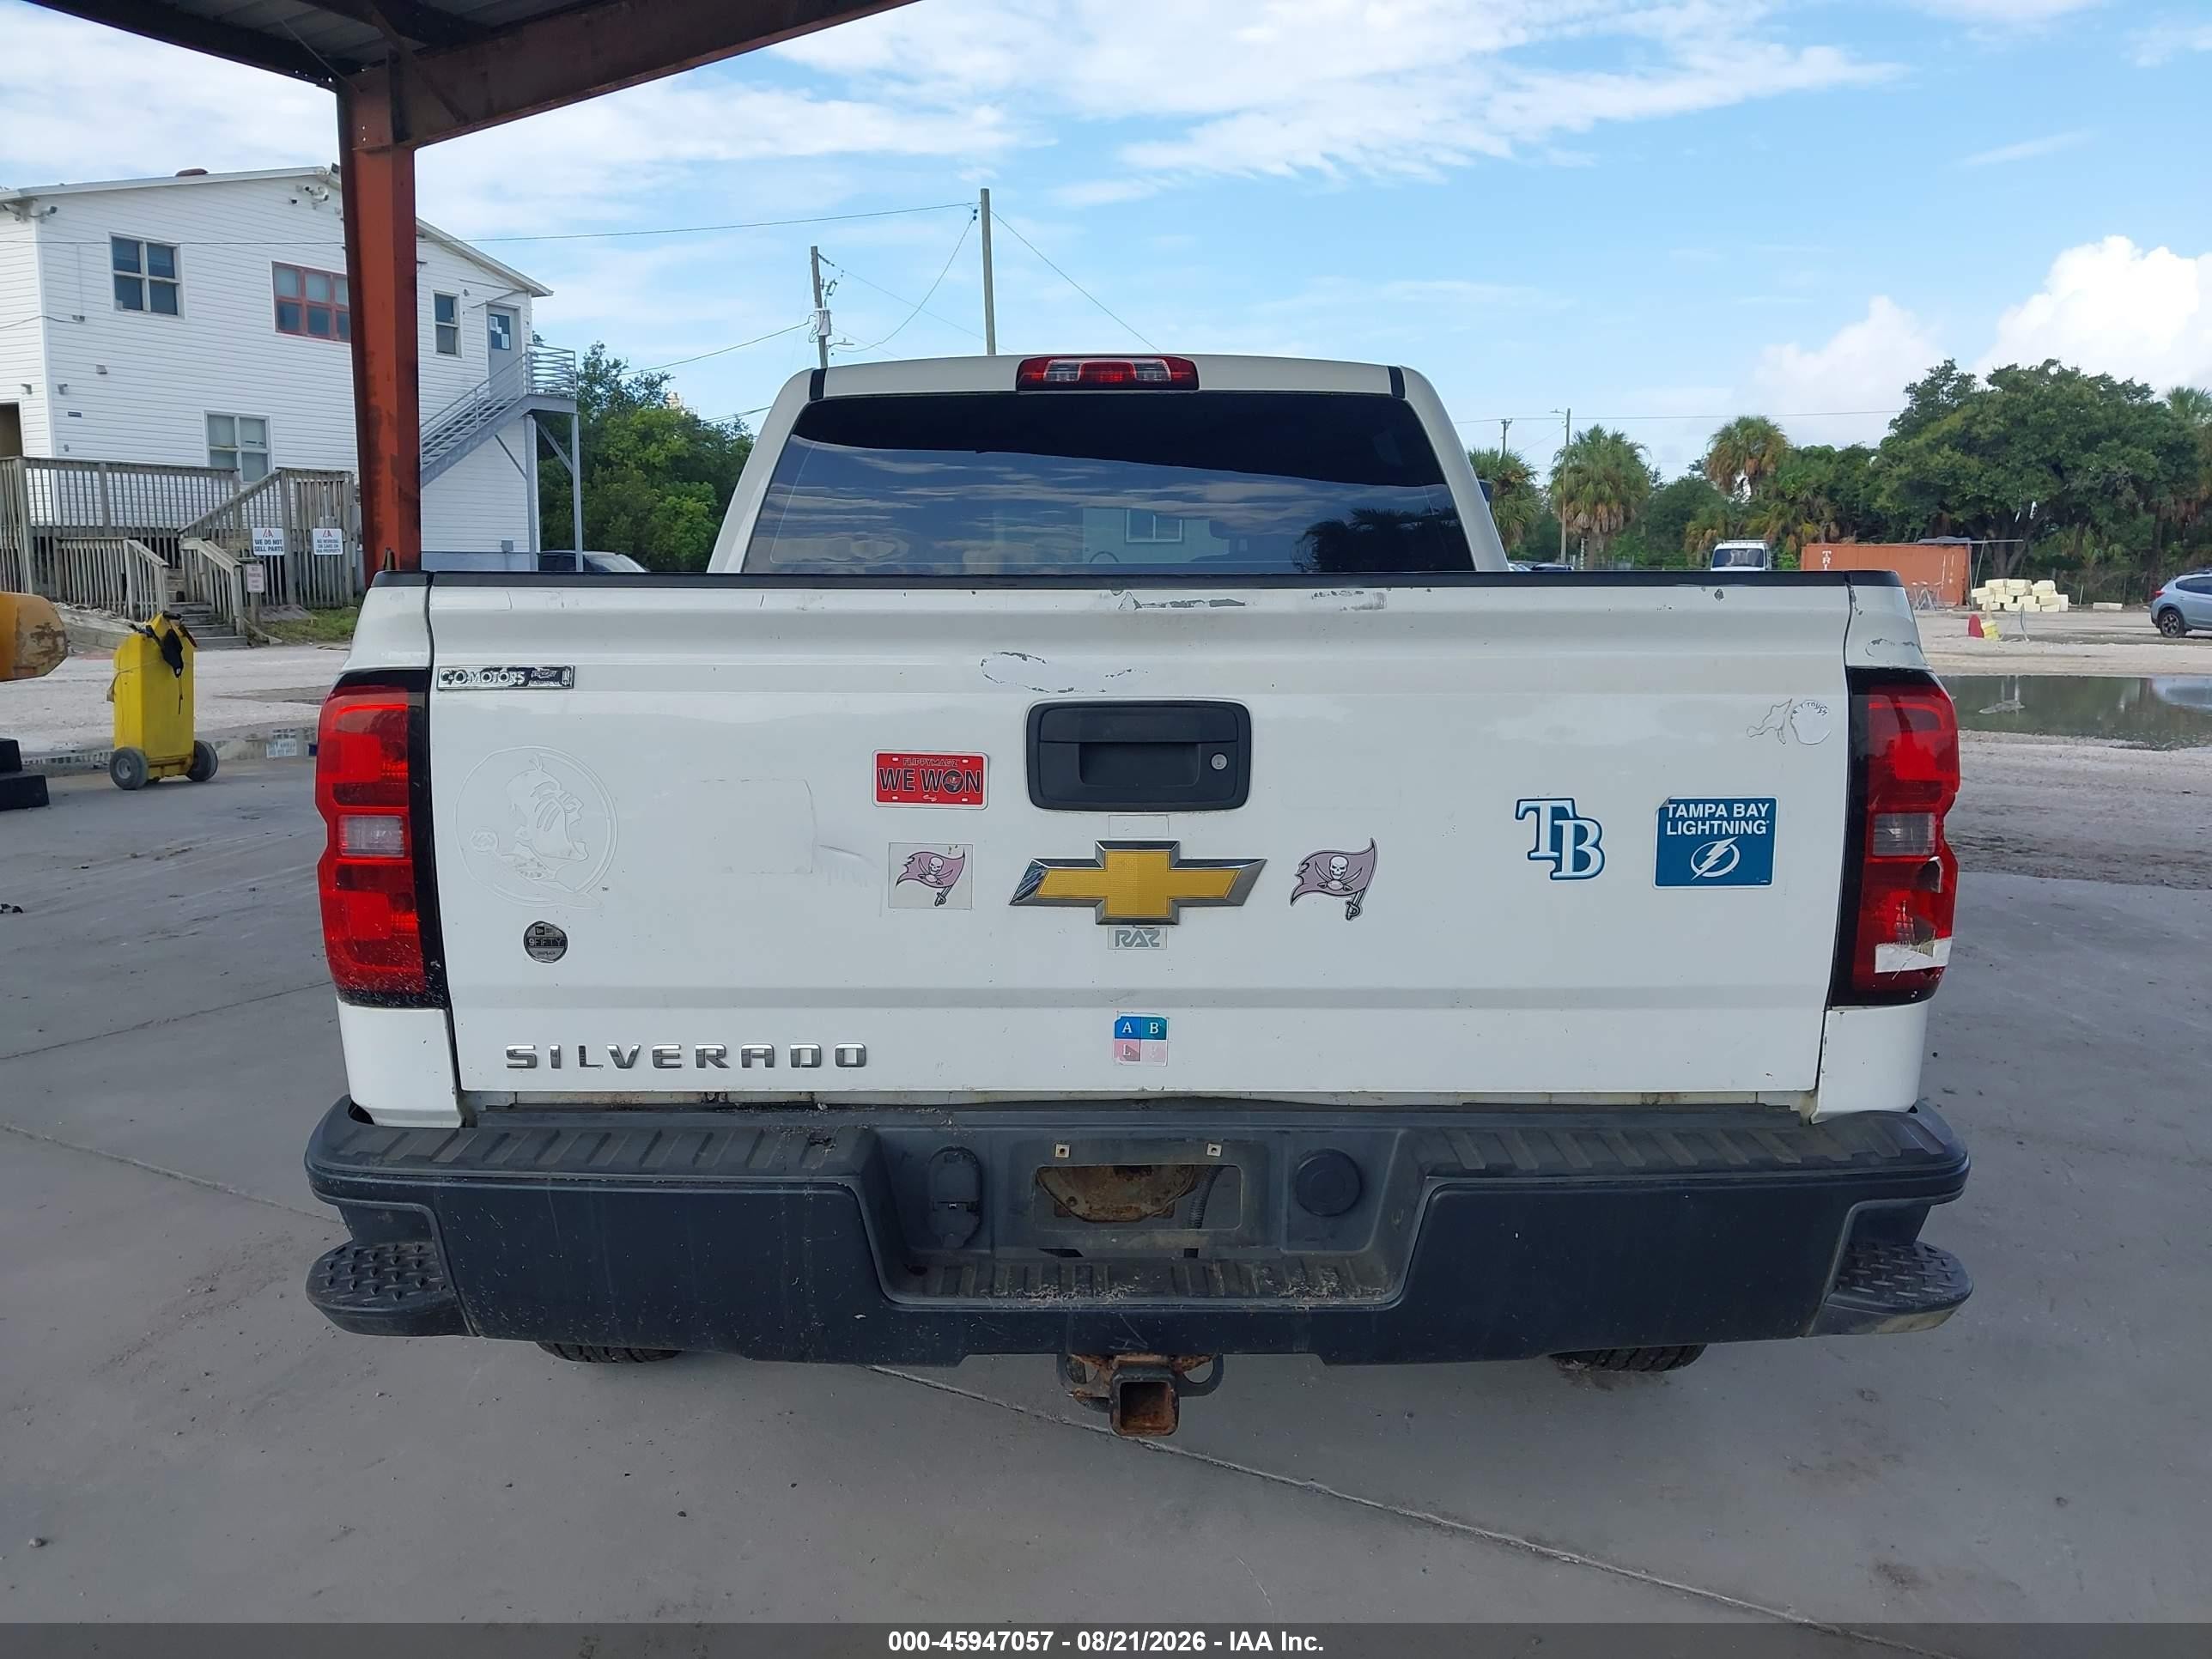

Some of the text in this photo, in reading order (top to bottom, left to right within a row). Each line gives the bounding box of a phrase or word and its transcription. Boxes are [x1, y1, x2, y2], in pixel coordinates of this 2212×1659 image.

[468, 671, 526, 684] MOTORS
[878, 767, 981, 794] WE WON
[1667, 803, 1770, 818] TAMPA BAY
[1666, 820, 1767, 836] LIGHTNING
[1515, 797, 1606, 880] TB
[528, 938, 562, 946] 9FIFTY
[1115, 929, 1161, 948] RAZ
[1121, 1022, 1159, 1034] A B
[505, 1043, 867, 1069] SILVERADO
[1122, 1044, 1131, 1056] L
